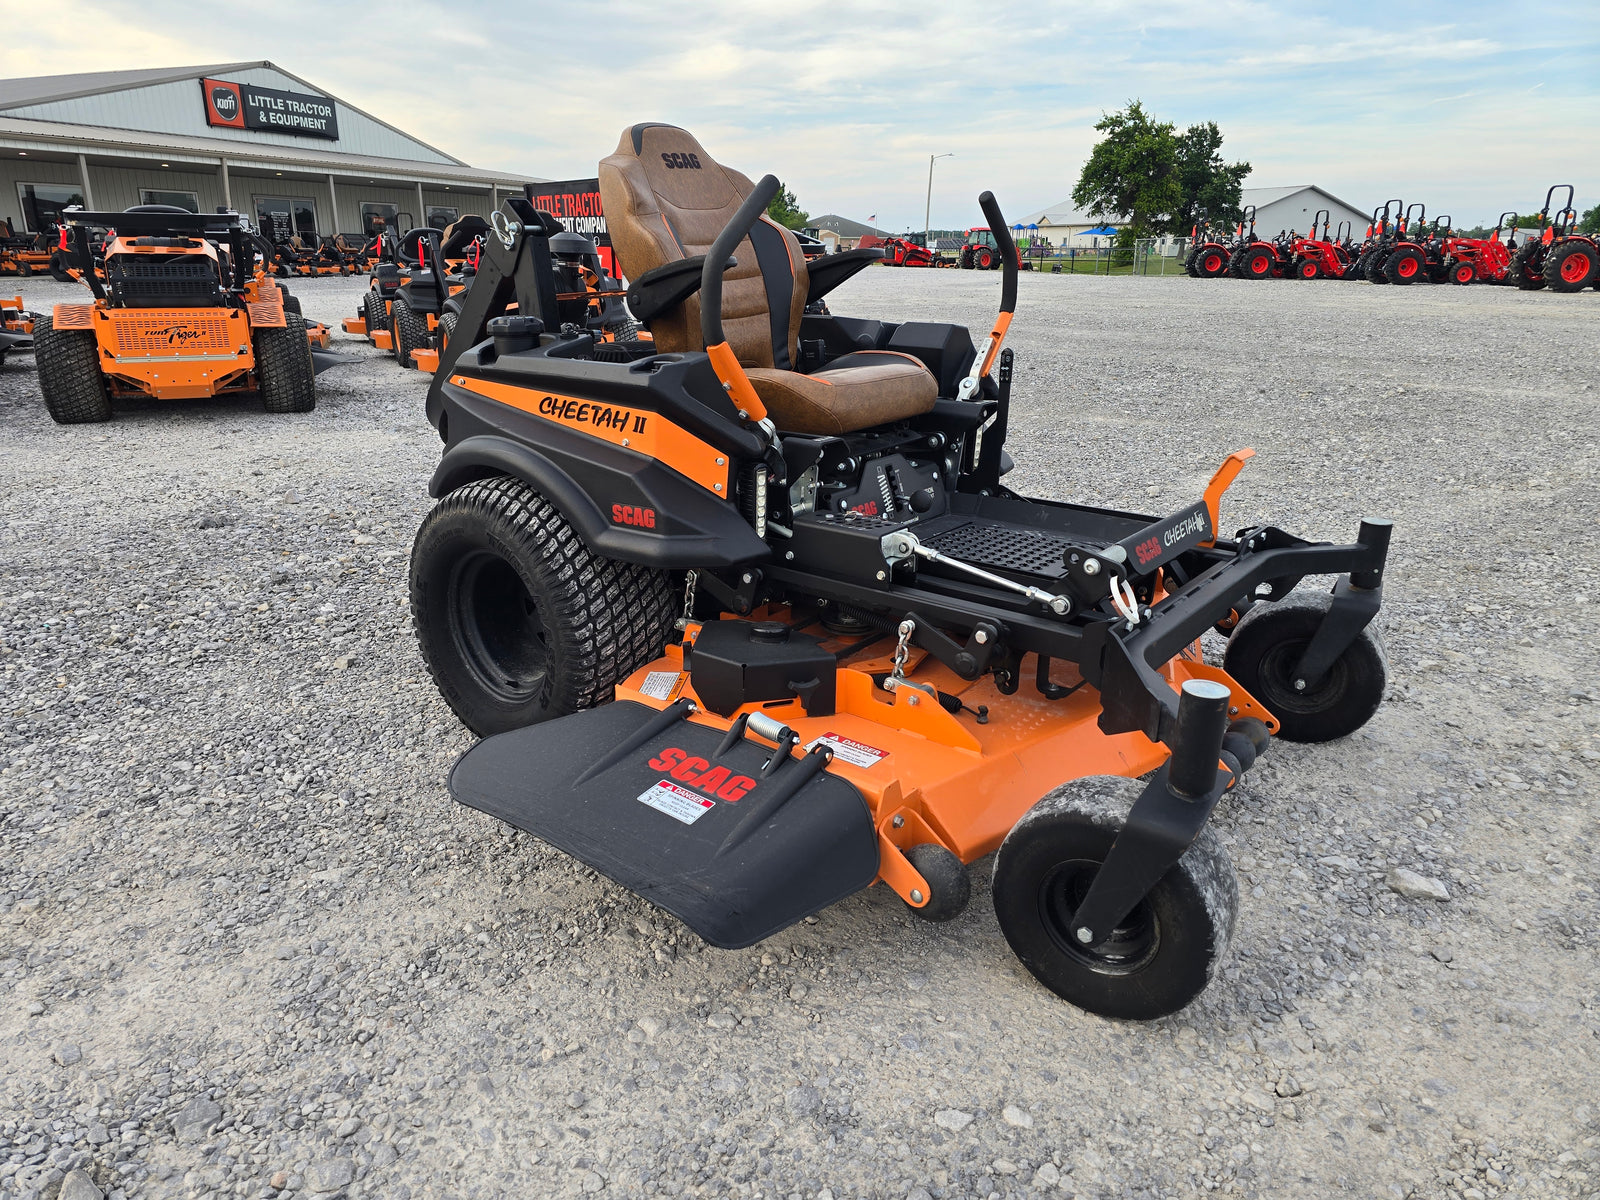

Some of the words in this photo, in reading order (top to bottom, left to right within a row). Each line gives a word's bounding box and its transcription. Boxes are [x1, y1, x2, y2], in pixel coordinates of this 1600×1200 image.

[248, 94, 285, 111] LITTLE
[286, 100, 332, 117] TRACTOR
[259, 111, 267, 123] &
[269, 112, 327, 130] EQUIPMENT
[661, 152, 702, 169] SCAG
[164, 326, 201, 344] Tiger
[539, 396, 630, 432] CHEETAH
[632, 415, 648, 434] II
[612, 504, 656, 529] SCAG
[1135, 536, 1163, 564] SCAG
[842, 739, 882, 756] DANGER
[648, 747, 757, 802] SCAG
[674, 787, 706, 804] DANGER
